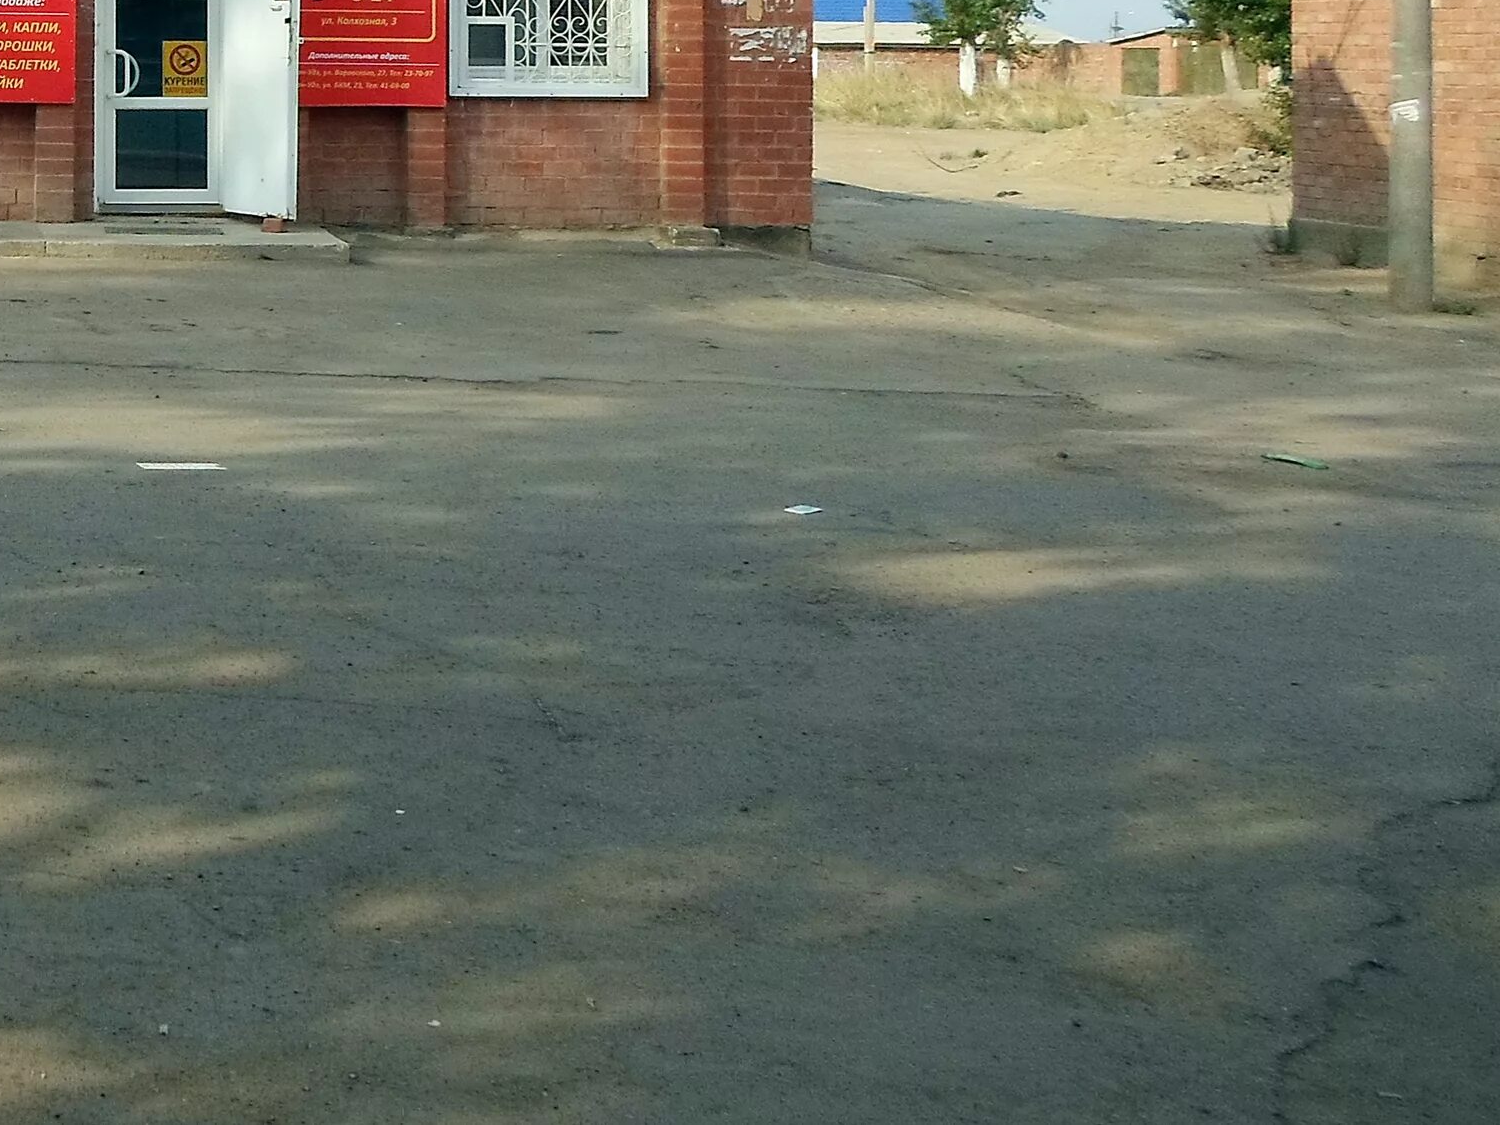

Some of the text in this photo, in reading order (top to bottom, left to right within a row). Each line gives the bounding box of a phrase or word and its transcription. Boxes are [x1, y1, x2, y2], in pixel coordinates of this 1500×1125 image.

[391, 17, 398, 25] 3
[13, 22, 62, 35] КАПЛИ,
[164, 77, 205, 86] КУРЕНИЕ
